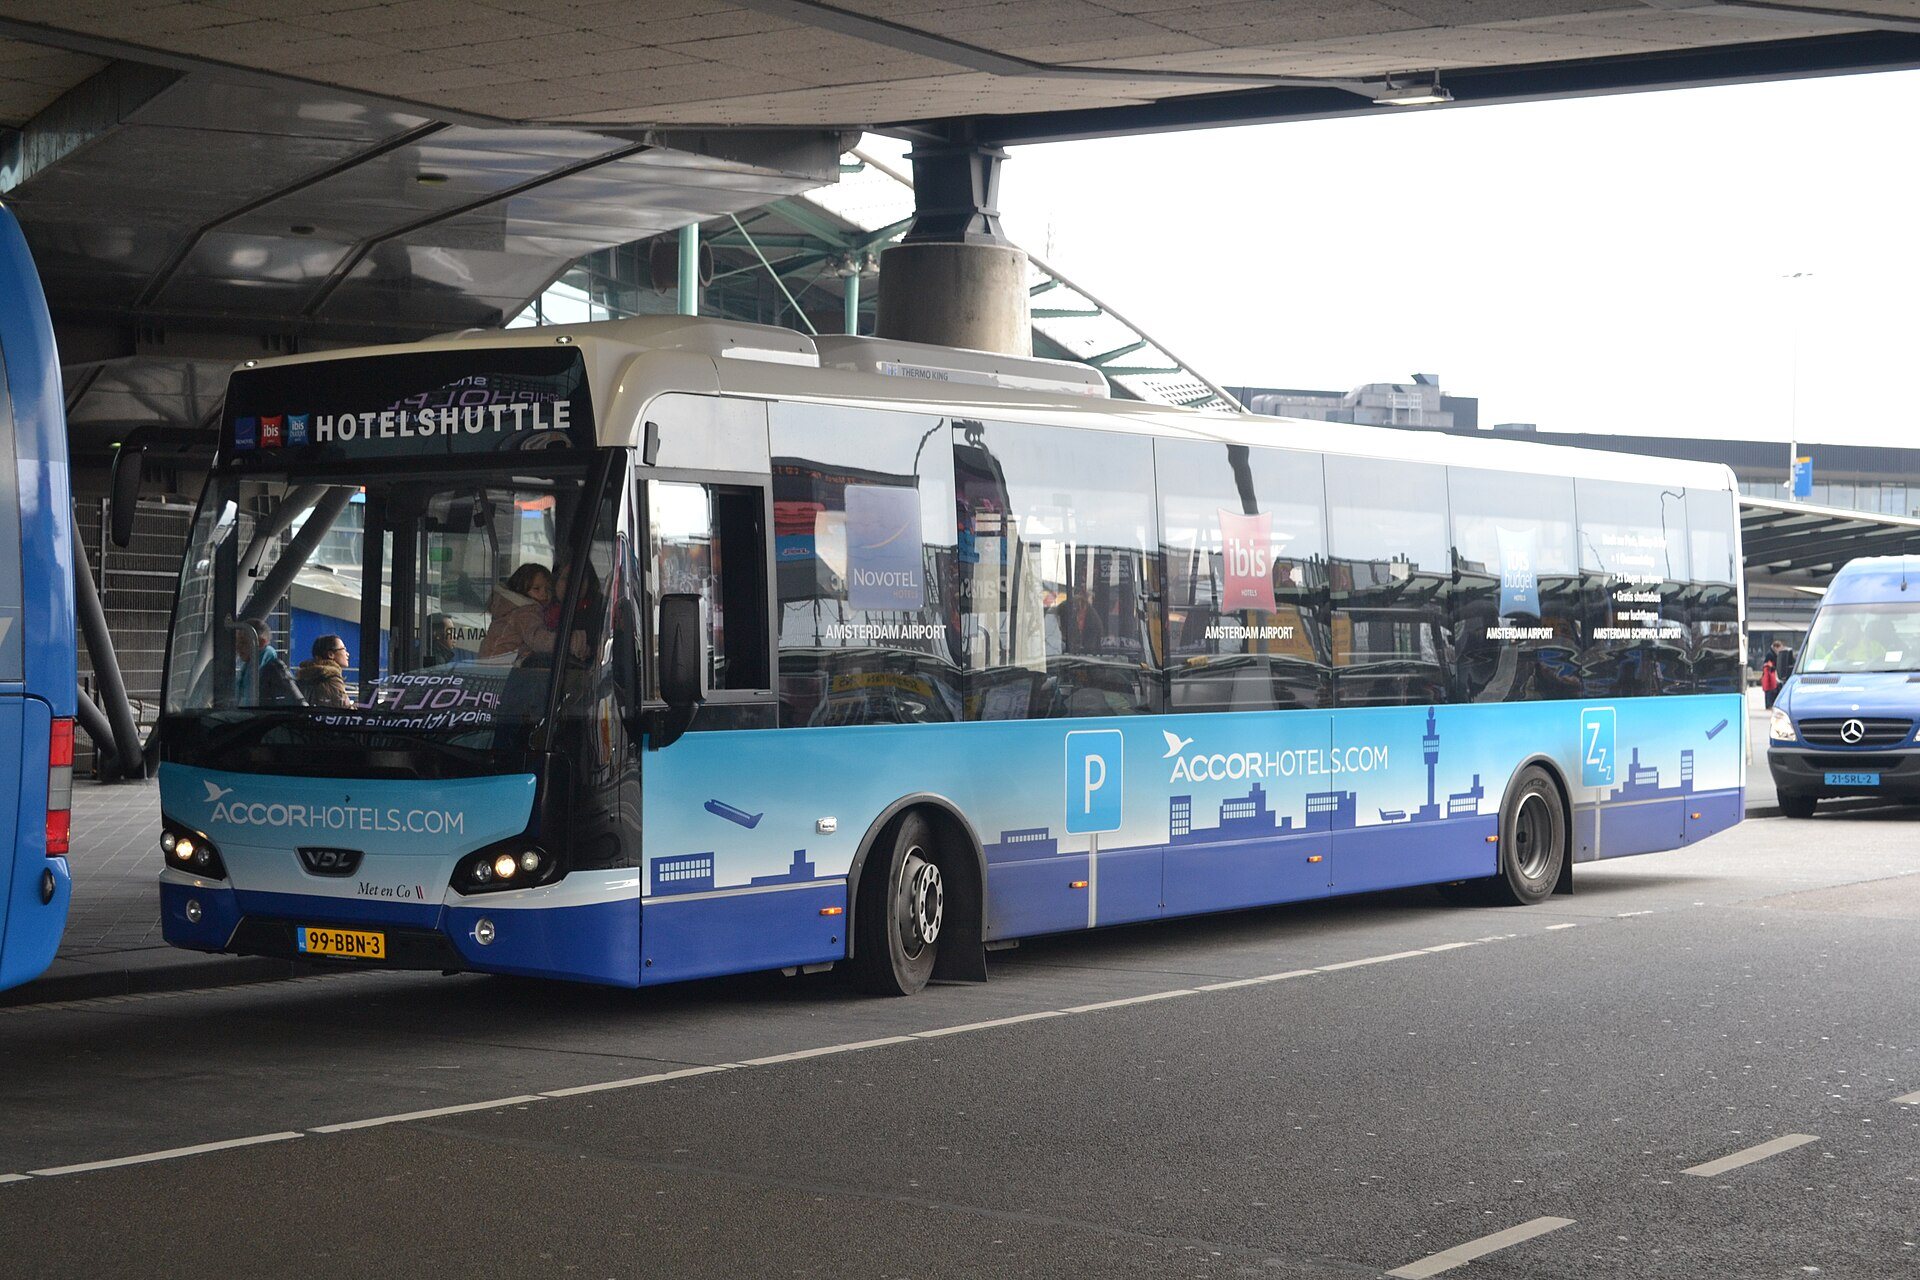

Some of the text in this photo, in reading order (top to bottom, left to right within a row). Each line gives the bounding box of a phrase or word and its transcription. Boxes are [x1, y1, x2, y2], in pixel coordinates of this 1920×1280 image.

[901, 367, 949, 381] THERMO KING
[263, 424, 279, 437] ibis
[316, 401, 571, 443] HOTELSHUTTLE
[1228, 537, 1266, 578] ibis
[853, 568, 918, 587] NOVOTEL
[1504, 569, 1533, 593] budget
[825, 624, 947, 641] AMSTERDAM AIRPORT
[1205, 626, 1293, 640] AMSTERDAM AIRPORT
[1486, 627, 1554, 640] AMSTERDAM AIRPORT
[1592, 627, 1682, 640] AMSTERDAM SCHIPHOL AIRPORT
[1169, 745, 1390, 785] ACCORHOTELS.COM
[1083, 753, 1107, 815] P
[1831, 773, 1873, 784] 21-SRL-2
[209, 801, 465, 836] ACCORHOTELS.COM
[306, 850, 352, 867] VDL
[357, 881, 411, 898] Met en Co
[309, 931, 381, 955] 99-BBN-3
